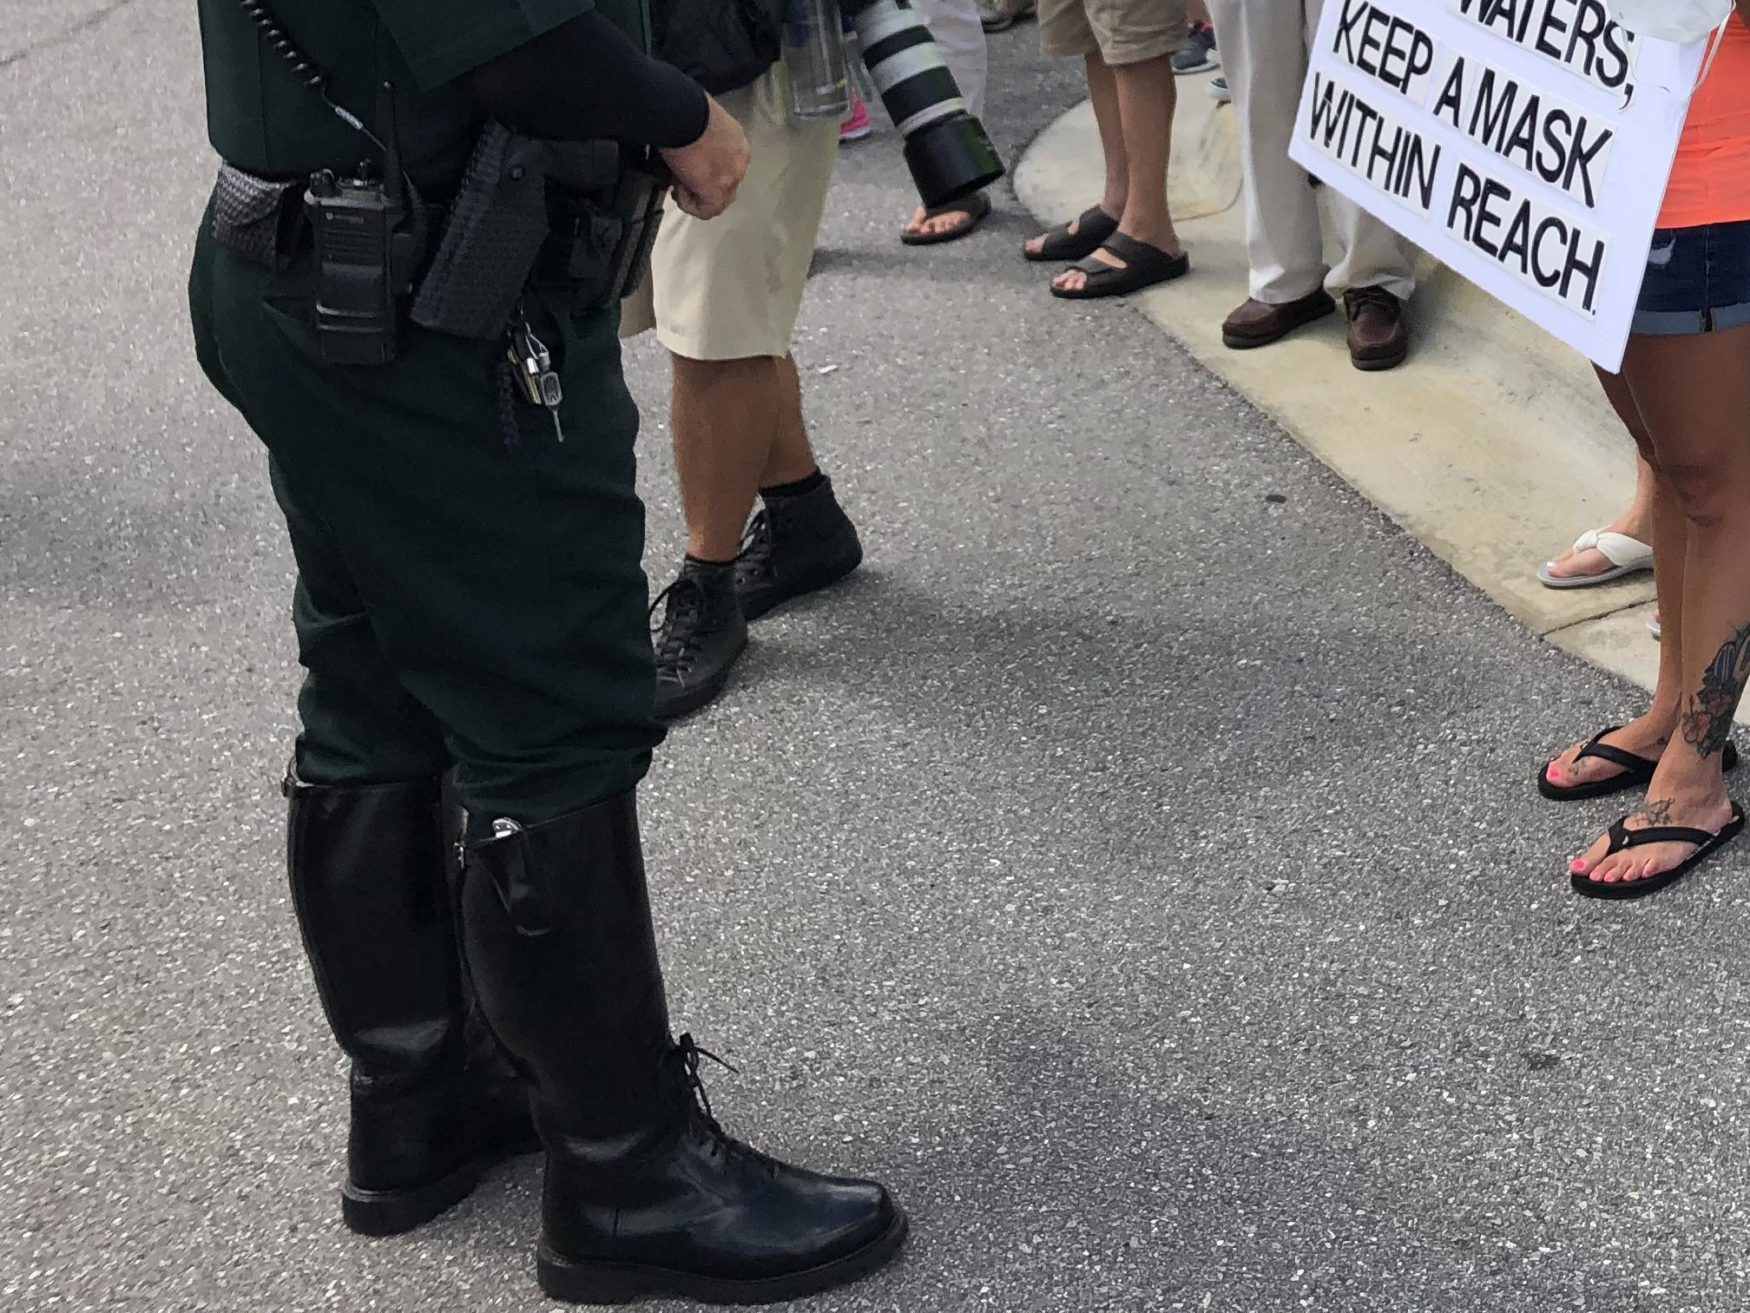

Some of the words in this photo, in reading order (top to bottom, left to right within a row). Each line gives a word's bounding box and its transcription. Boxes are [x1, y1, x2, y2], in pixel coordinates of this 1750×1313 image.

[1311, 70, 1442, 210] WITHIN
[1432, 55, 1465, 126] A
[1467, 69, 1614, 209] MASK
